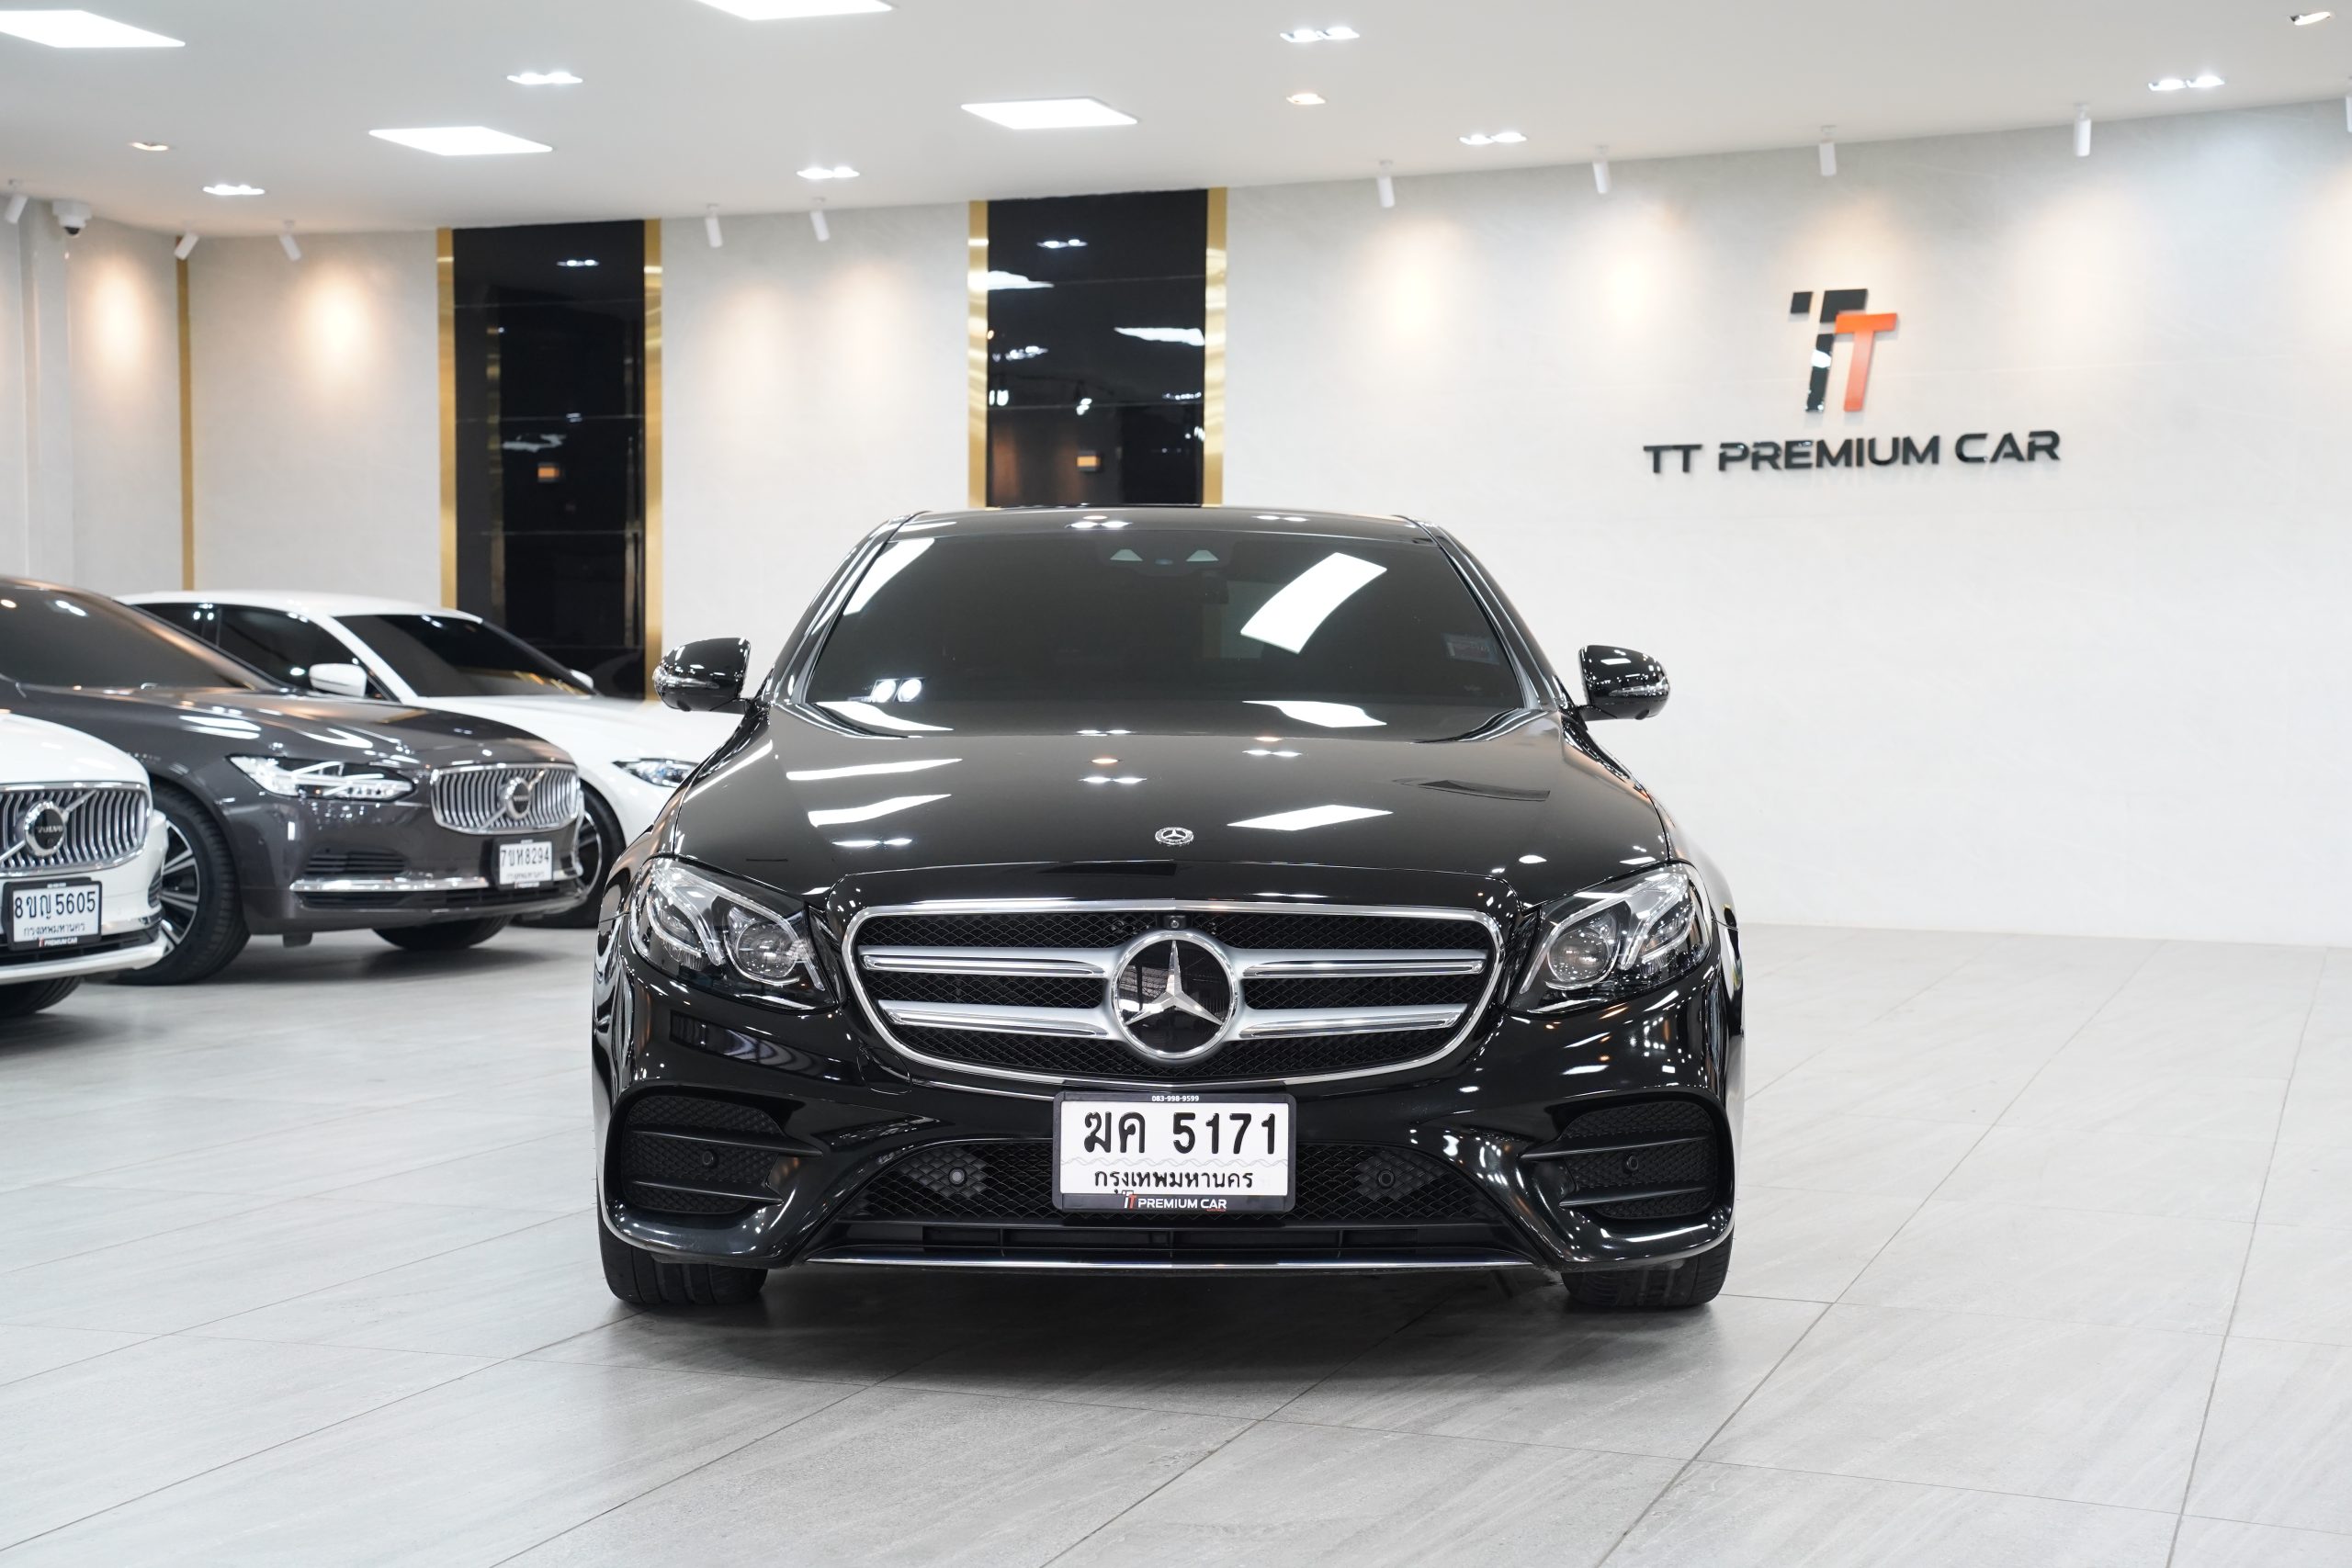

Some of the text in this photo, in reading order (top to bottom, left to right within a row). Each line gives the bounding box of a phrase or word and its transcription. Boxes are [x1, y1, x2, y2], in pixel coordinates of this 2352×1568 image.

[1643, 430, 2061, 473] TT PREMIUM CAR
[1084, 1111, 1275, 1154] ฆค 5171
[1094, 1170, 1253, 1194] กรุงเทพมหานคร
[1137, 1198, 1198, 1209] PREMIUM
[1200, 1199, 1227, 1209] CAR
